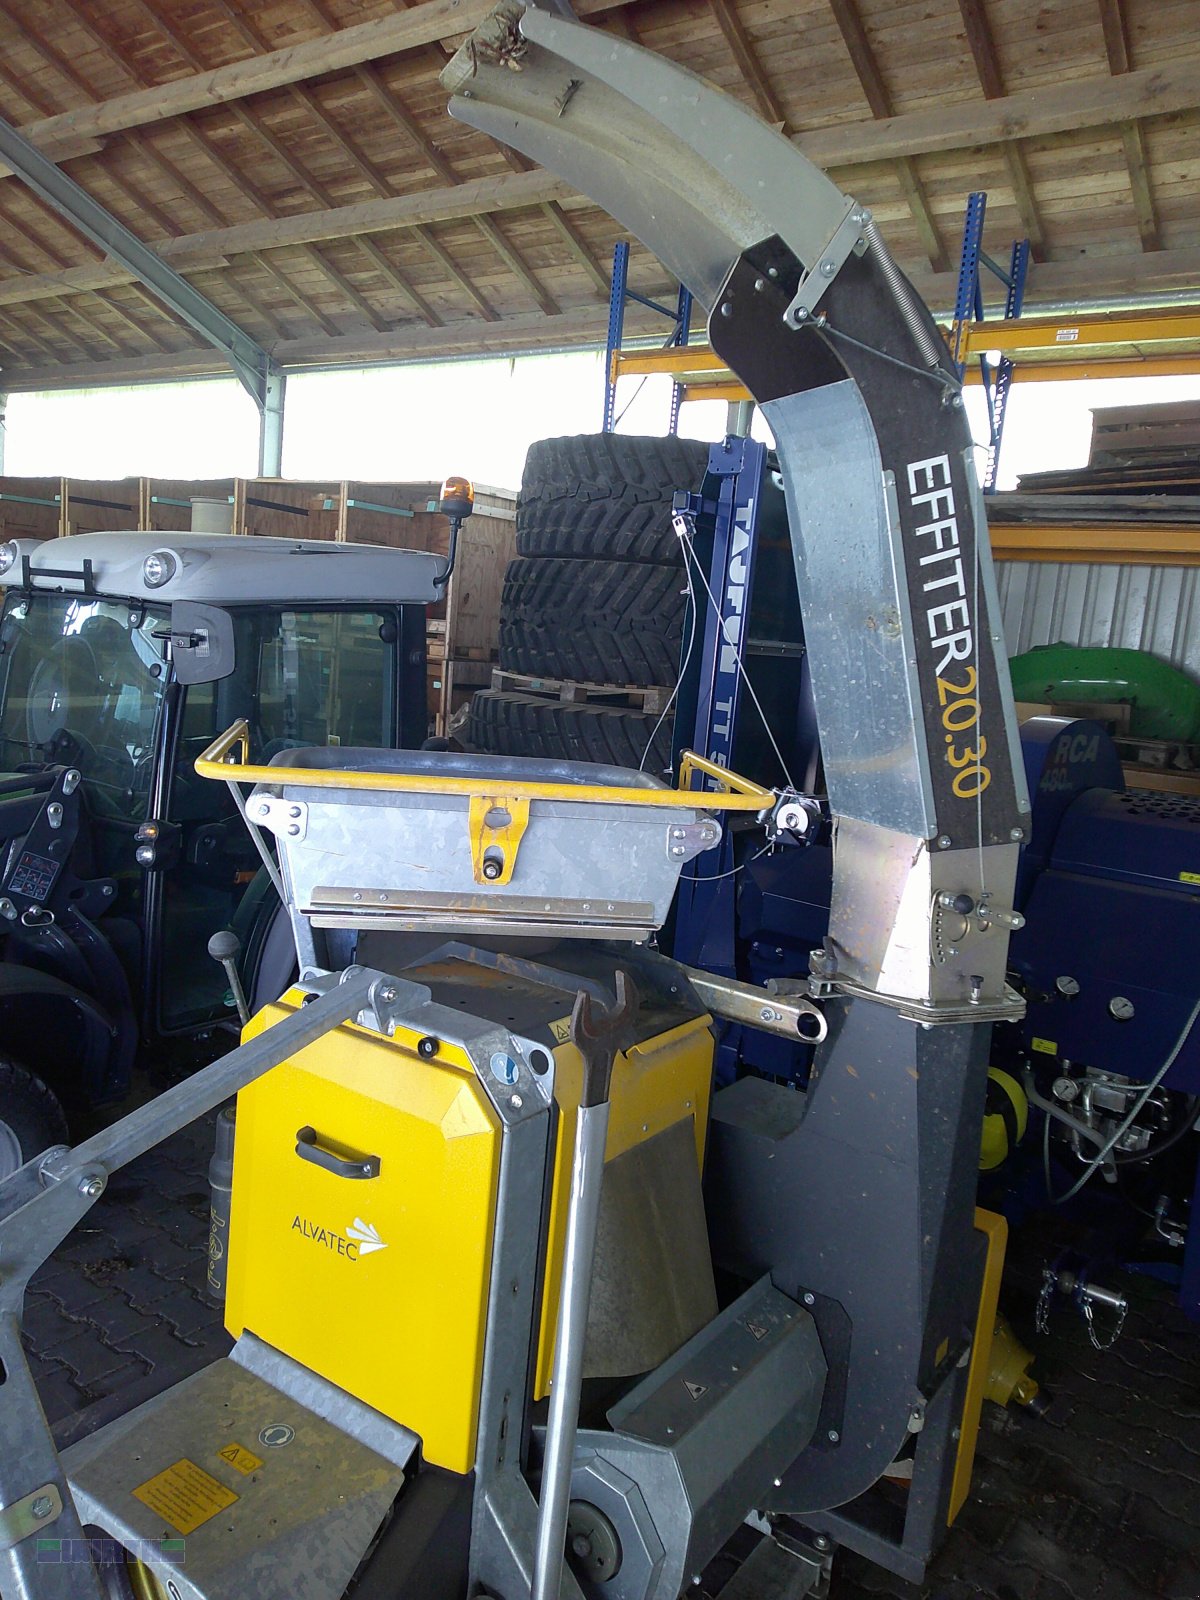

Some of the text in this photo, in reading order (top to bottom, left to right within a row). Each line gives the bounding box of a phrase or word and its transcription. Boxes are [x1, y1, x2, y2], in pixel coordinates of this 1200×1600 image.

[713, 498, 754, 742] TAJFUN TT
[906, 453, 992, 799] EFFITER 20.30
[1053, 734, 1101, 764] RCA
[291, 1215, 358, 1262] ALVATEC
